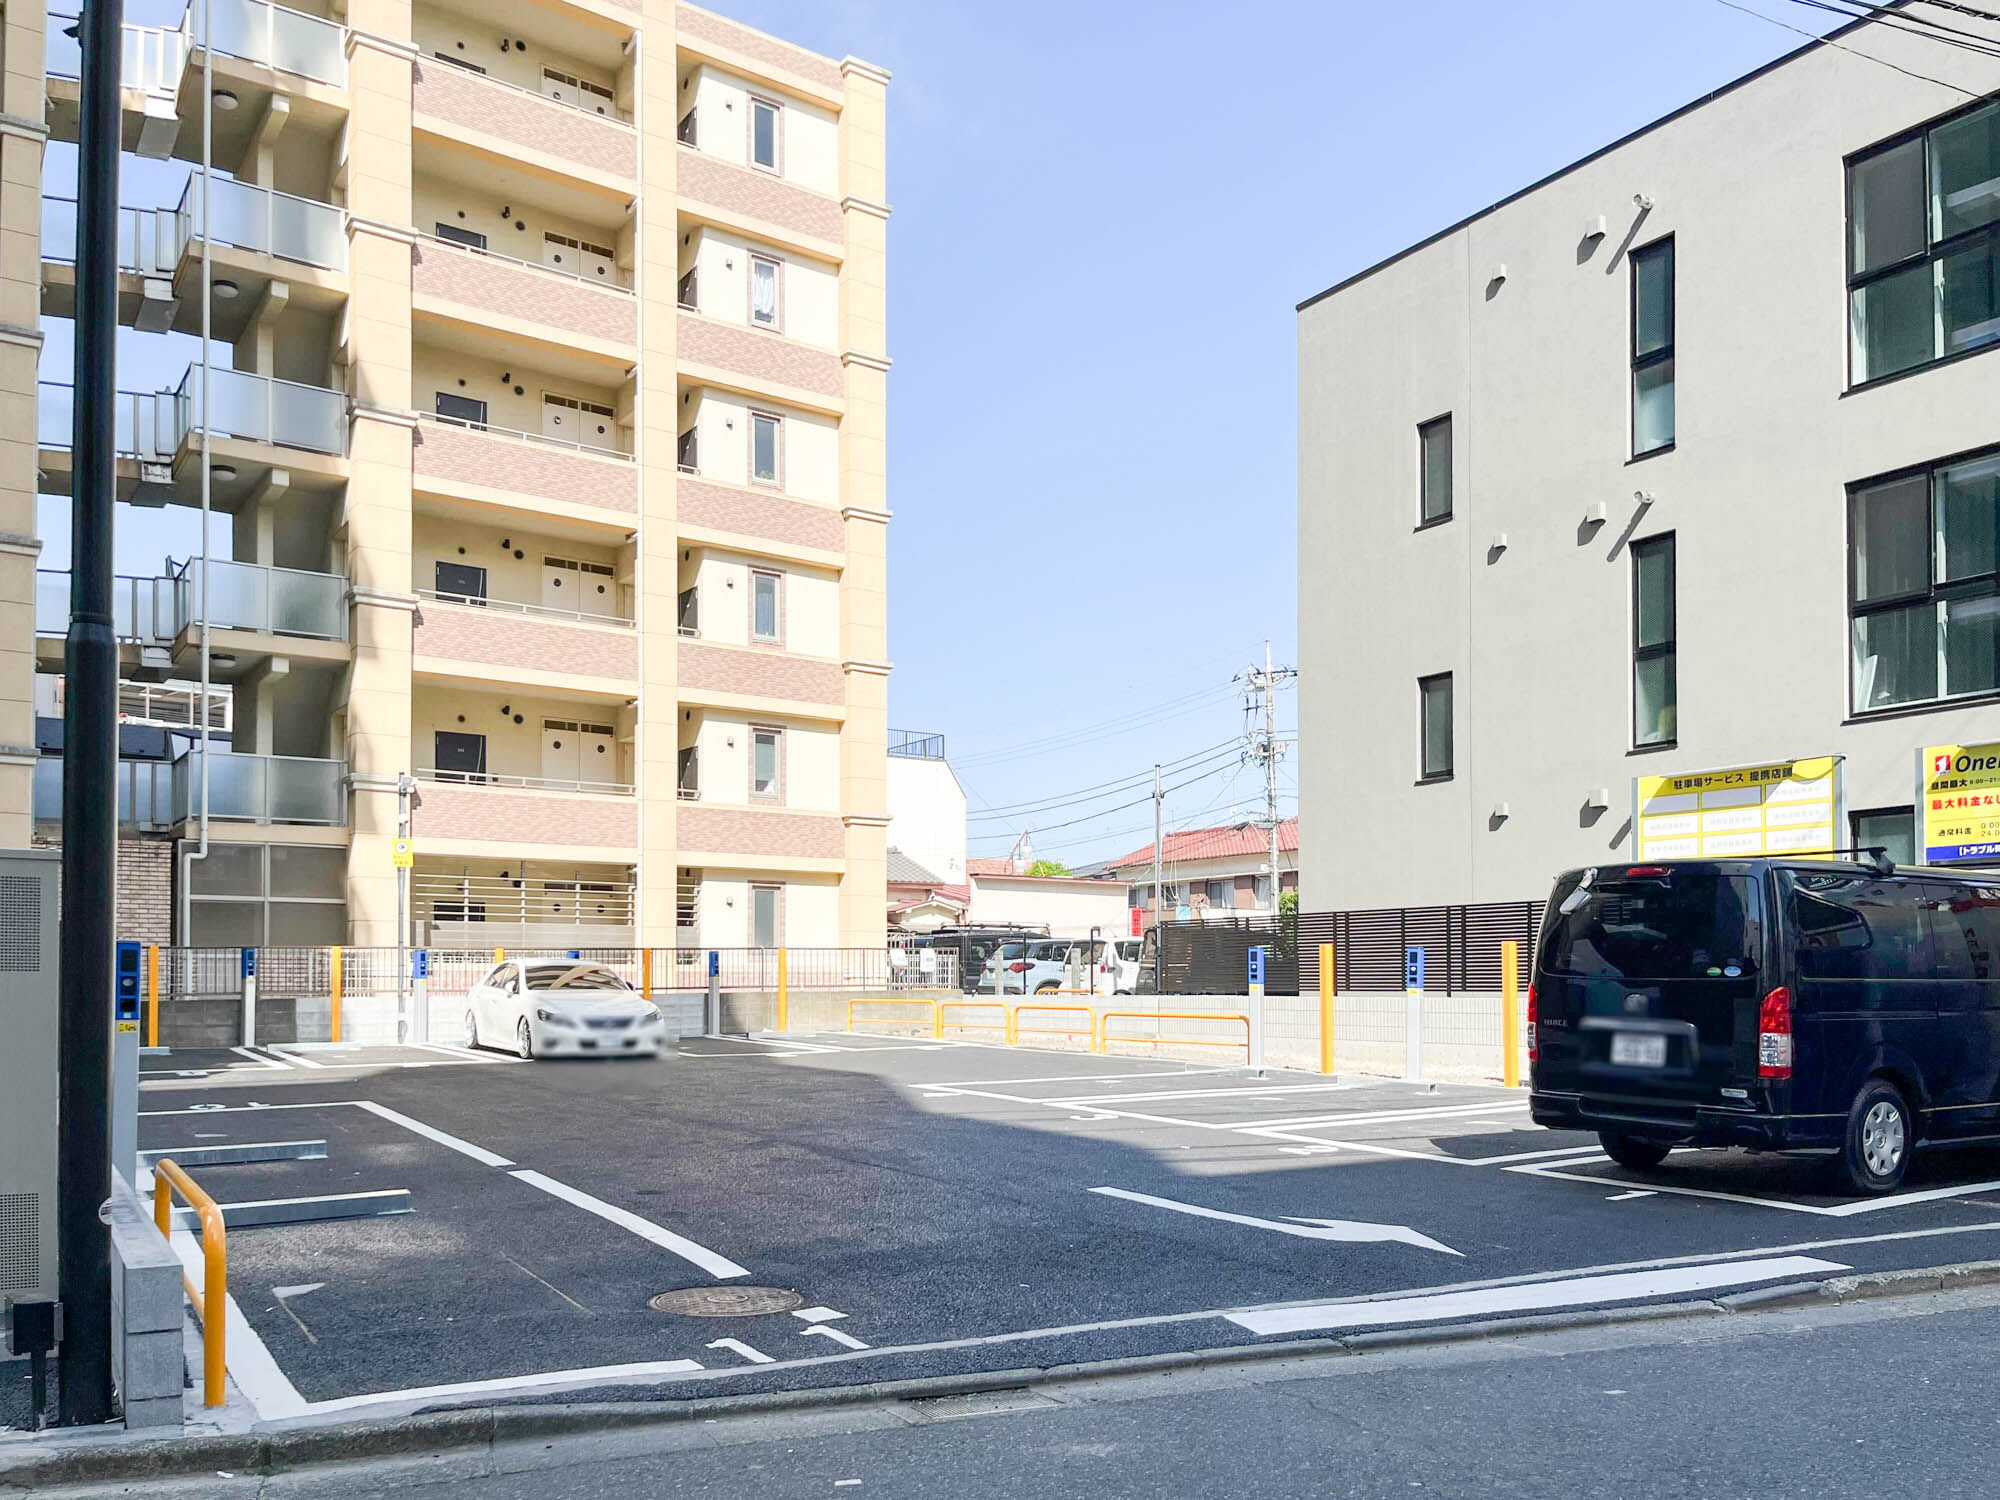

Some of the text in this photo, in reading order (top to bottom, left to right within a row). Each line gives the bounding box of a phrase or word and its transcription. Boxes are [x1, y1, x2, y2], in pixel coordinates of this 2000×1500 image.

[1955, 755, 2000, 772] One
[1674, 773, 1744, 789] 駐車場サービス
